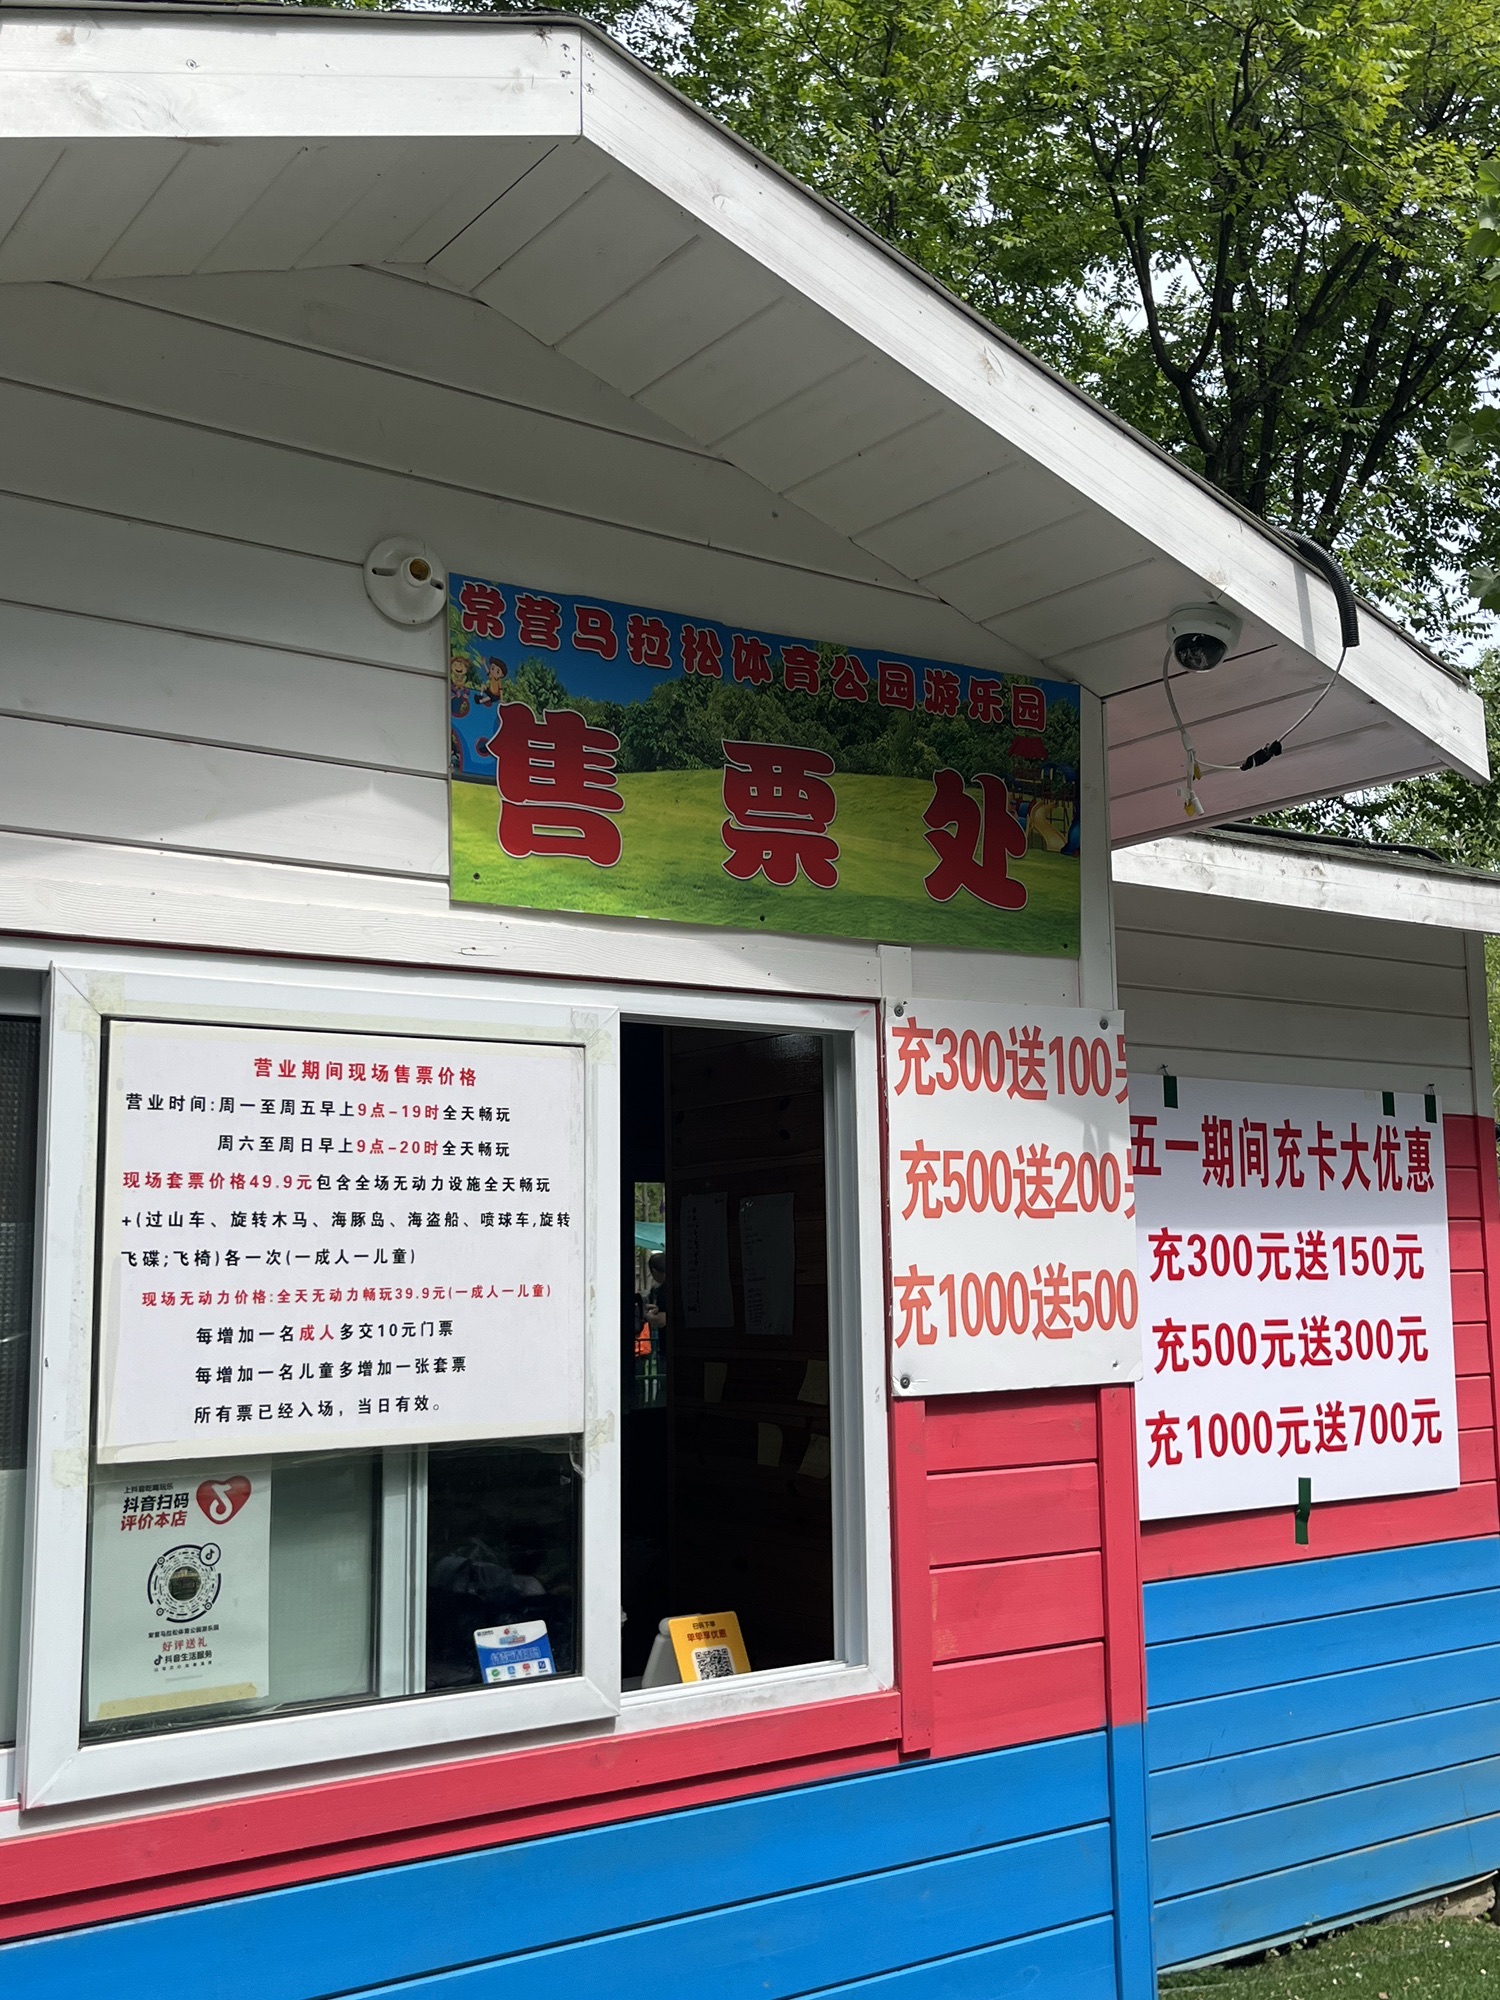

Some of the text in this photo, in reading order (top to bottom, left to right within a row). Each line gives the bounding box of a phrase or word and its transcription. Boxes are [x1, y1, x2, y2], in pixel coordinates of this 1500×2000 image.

[459, 582, 1047, 732] 常营马拉松体育公园游乐园
[486, 700, 1028, 911] 售票处
[254, 1057, 477, 1087] 营业期间现场售票价格
[217, 1135, 510, 1158] 周六至周日早上9点-20时全天畅玩
[1129, 1114, 1435, 1193] 五一期间充卡大优惠
[122, 1172, 551, 1193] 现场套票价格49.9元包含全场无动力设施全天畅玩
[900, 1139, 1136, 1221] 充500送200
[1148, 1227, 1425, 1283] 充300元送150元
[894, 1262, 1138, 1349] 充1000送500
[196, 1320, 453, 1345] 每增加一名成人多交10元门票
[1152, 1315, 1429, 1374] 充500元送300元
[195, 1356, 467, 1385] 每增加一名儿童多增加一张套票
[1145, 1398, 1442, 1468] 充1000元送700元
[122, 1492, 189, 1514] 抖音扫码
[120, 1510, 188, 1531] 评价本店
[162, 1637, 207, 1652] 好评送礼
[164, 1650, 212, 1664] 抖音生活服务
